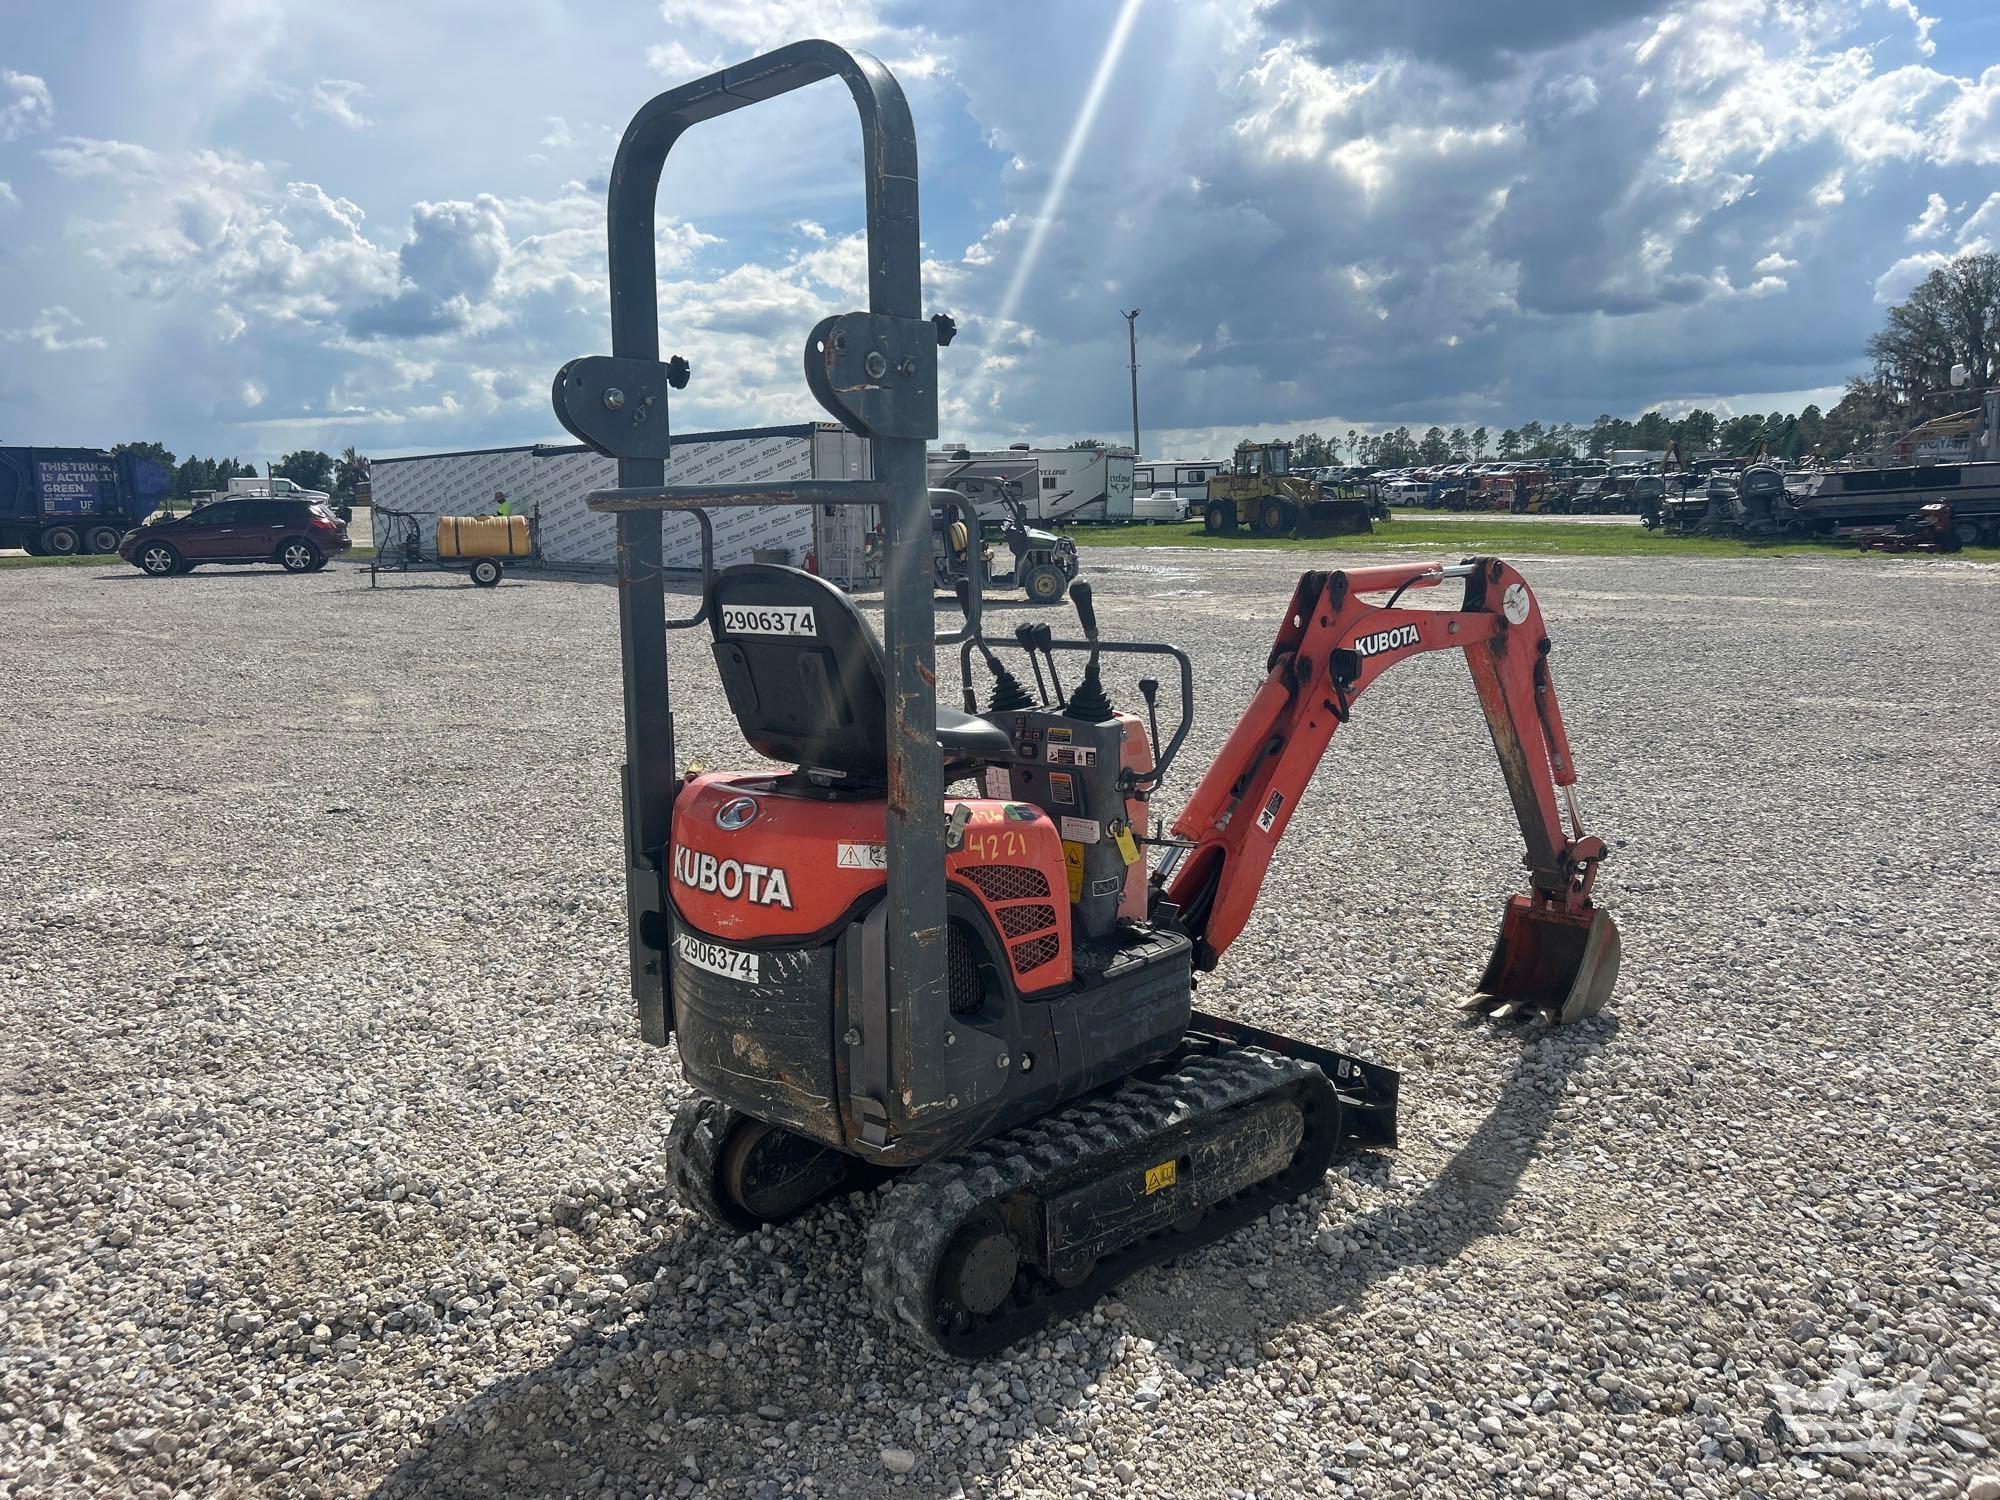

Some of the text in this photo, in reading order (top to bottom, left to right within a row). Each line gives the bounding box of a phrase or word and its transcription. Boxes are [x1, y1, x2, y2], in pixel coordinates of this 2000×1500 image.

[40, 462, 68, 472] THIS
[41, 473, 55, 482] IS
[80, 500, 94, 510] UF
[724, 611, 815, 633] 2906374
[1355, 624, 1420, 656] KUBOTA
[969, 830, 1027, 861] 4221
[674, 843, 793, 909] KUBOTA
[683, 936, 752, 977] 2906374
